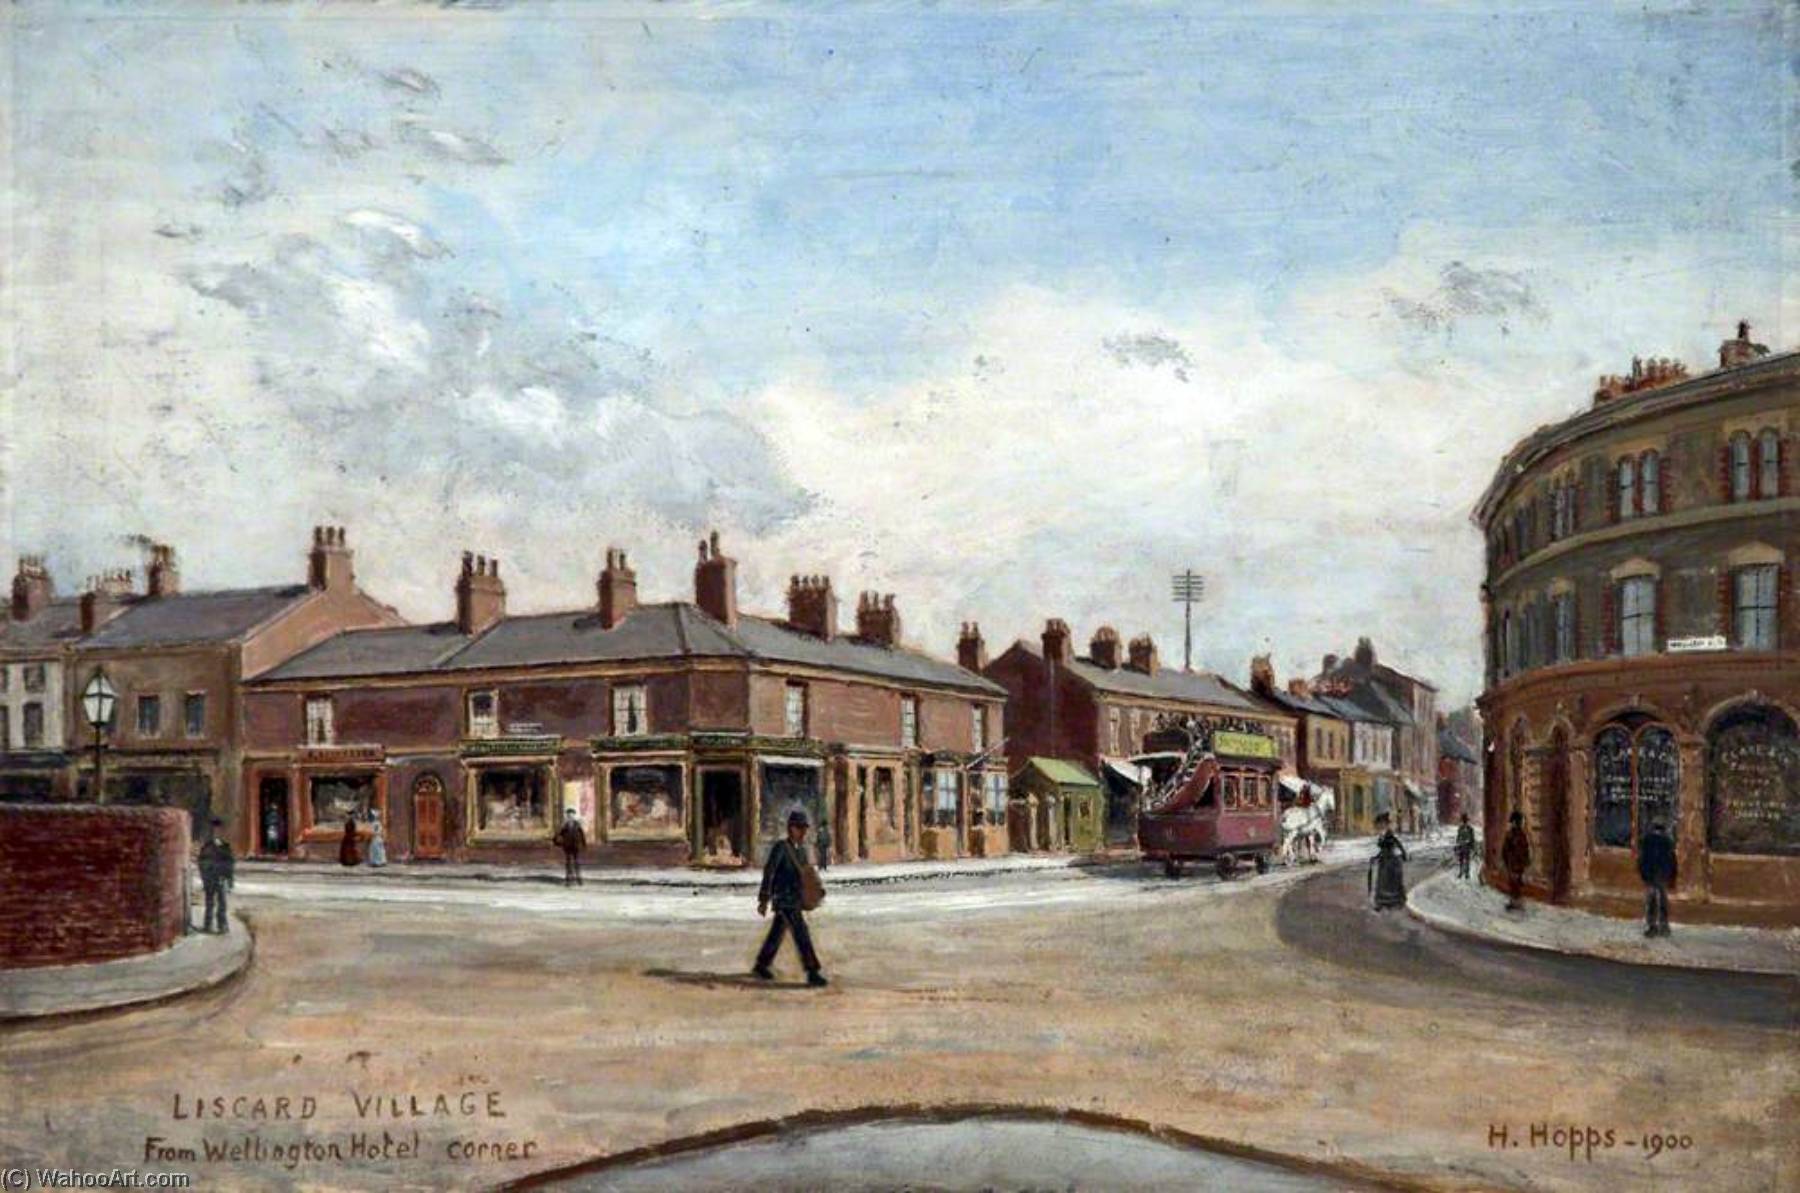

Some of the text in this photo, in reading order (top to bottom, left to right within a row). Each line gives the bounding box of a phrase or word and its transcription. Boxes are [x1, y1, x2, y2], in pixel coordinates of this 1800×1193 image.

[172, 1090, 506, 1120] LISCARD VILLAGE
[144, 1130, 538, 1171] From Wellington Hotel corner
[1488, 1123, 1519, 1149] H.
[1529, 1122, 1616, 1162] Hopps
